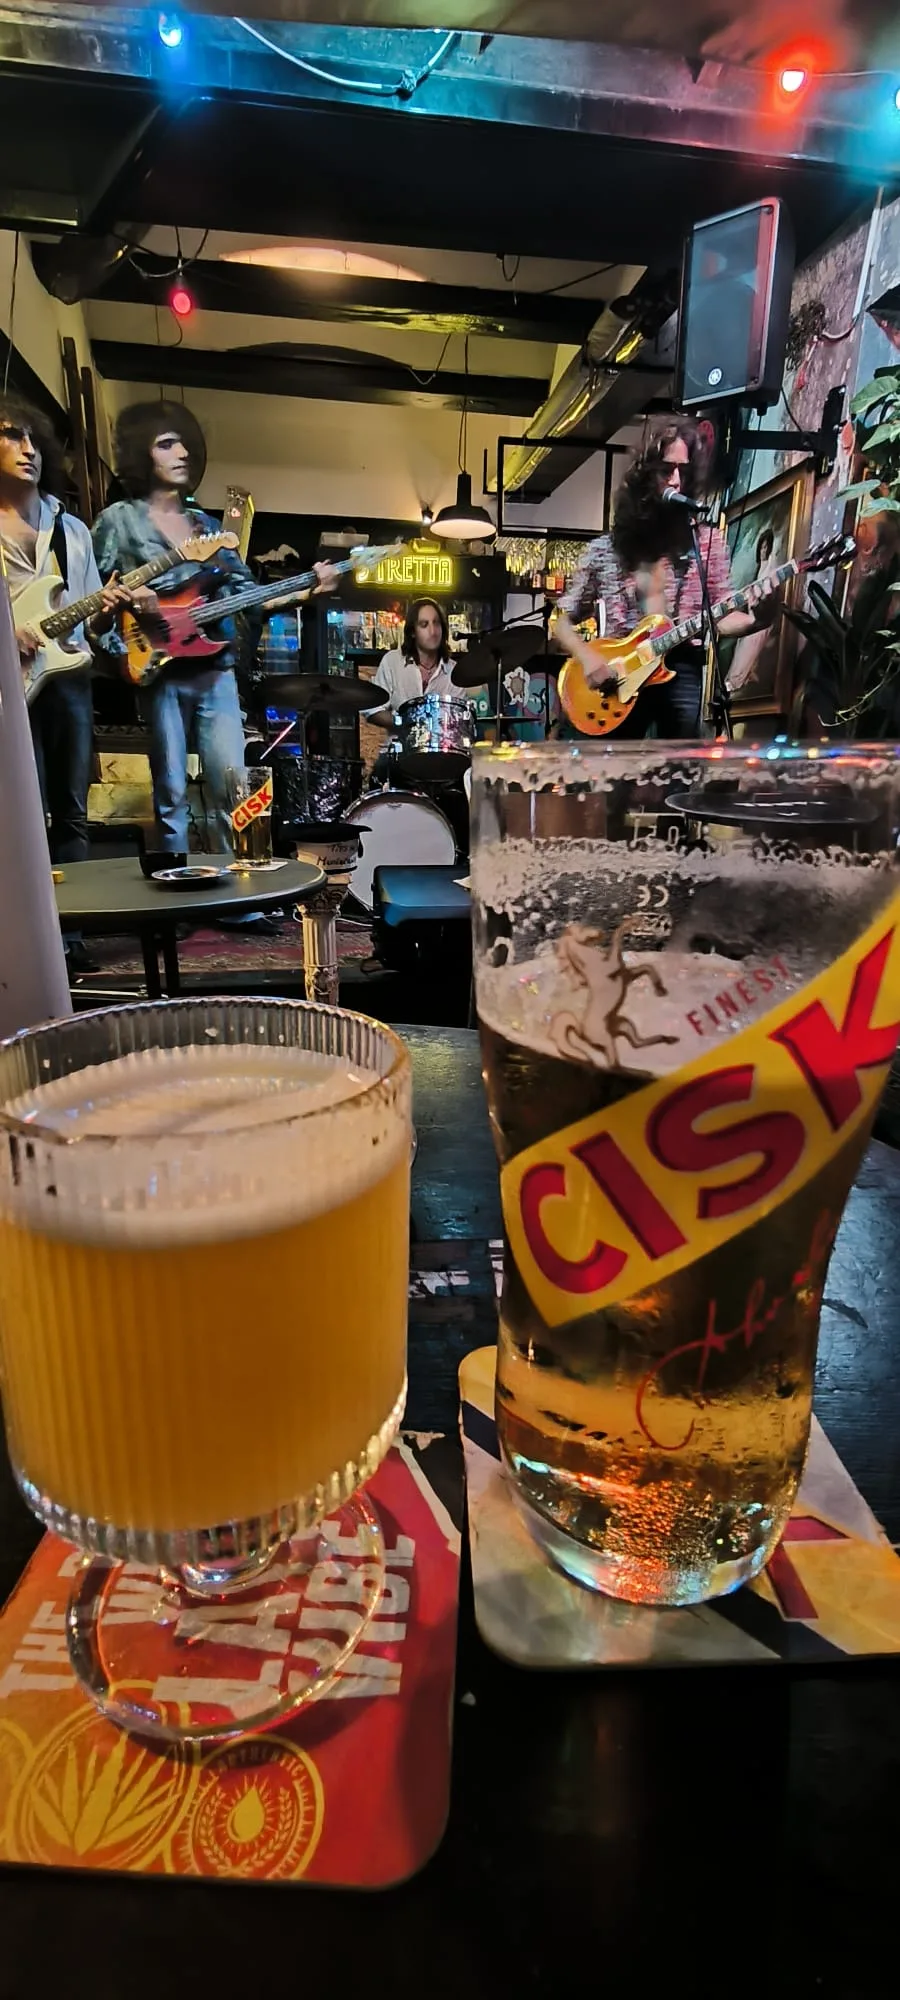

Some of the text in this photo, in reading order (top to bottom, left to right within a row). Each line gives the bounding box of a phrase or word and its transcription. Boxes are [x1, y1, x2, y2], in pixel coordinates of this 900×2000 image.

[233, 786, 272, 828] CISK
[684, 955, 793, 1036] FINEST
[519, 924, 900, 1295] CISK
[0, 1601, 82, 1700] THE
